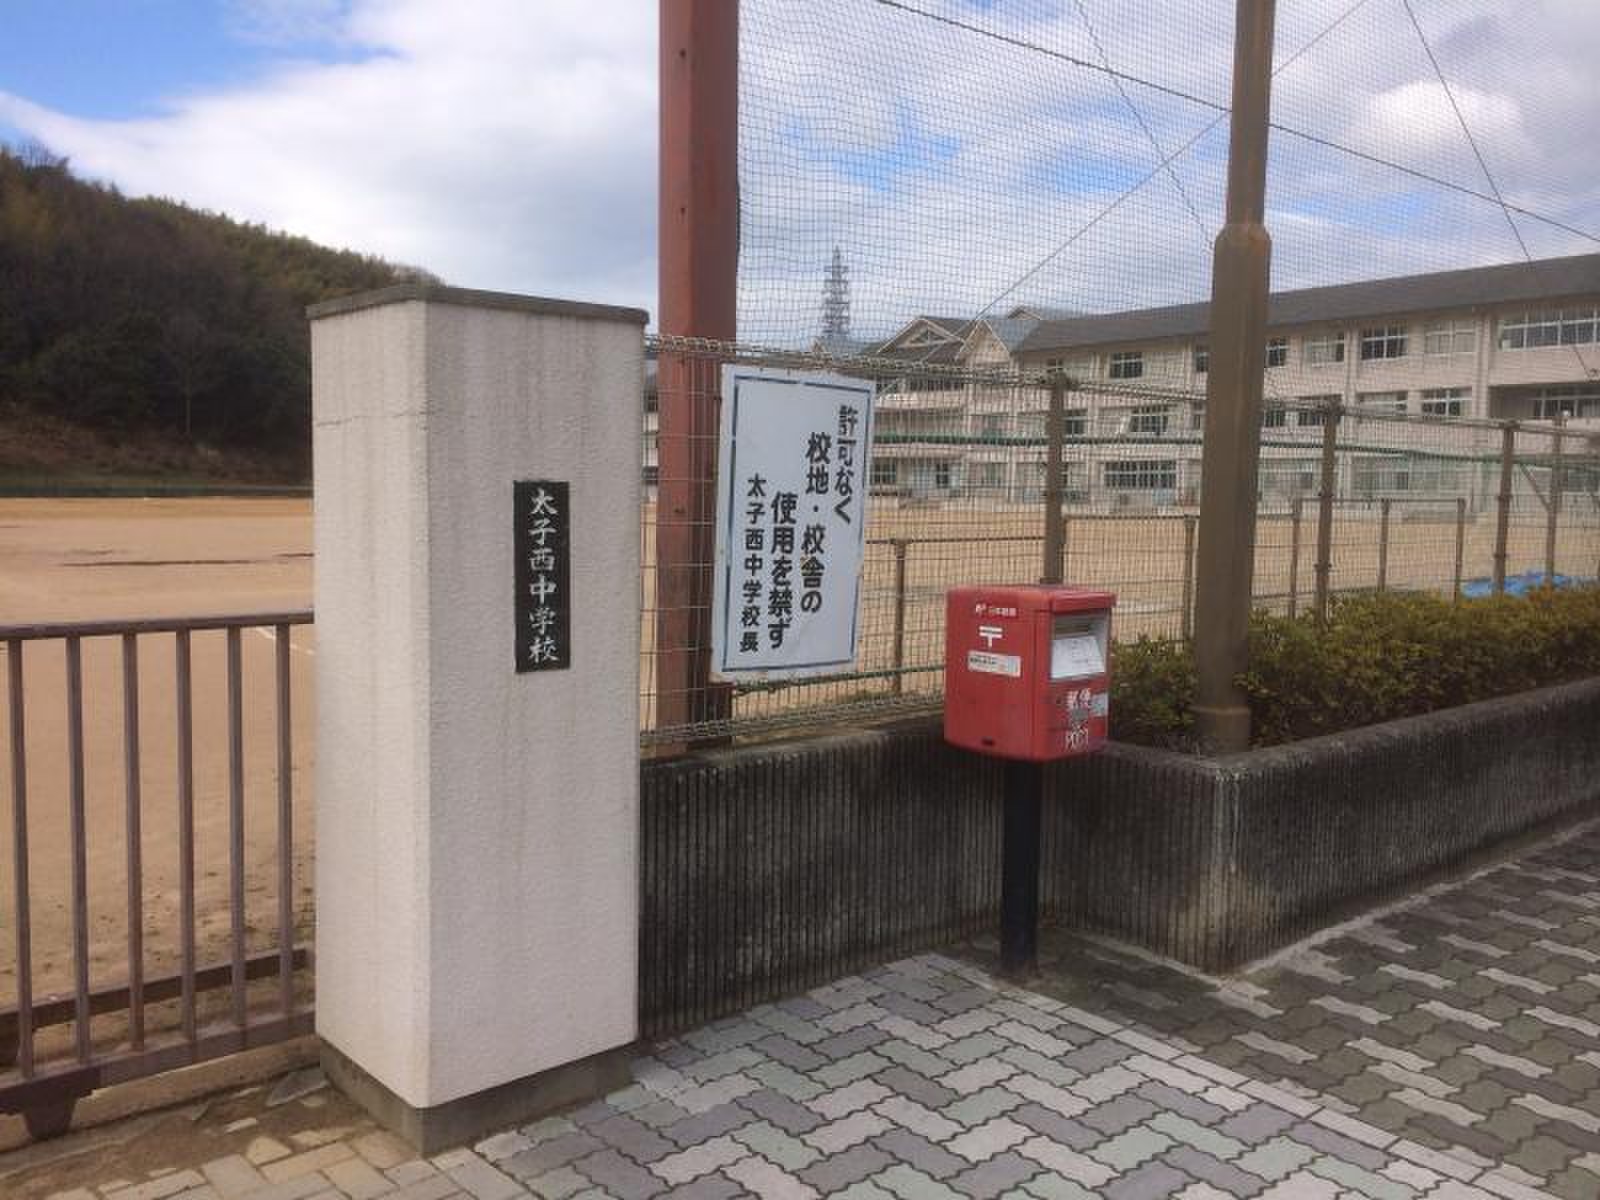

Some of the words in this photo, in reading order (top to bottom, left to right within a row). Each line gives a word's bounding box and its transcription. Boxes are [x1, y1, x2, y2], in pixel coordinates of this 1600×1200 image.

[801, 431, 832, 614] 校地・校舎の
[834, 405, 858, 524] 許可なく
[528, 488, 559, 664] 太子西中学校
[740, 473, 767, 652] 太子西中学校長
[767, 491, 798, 650] 使用を禁ず
